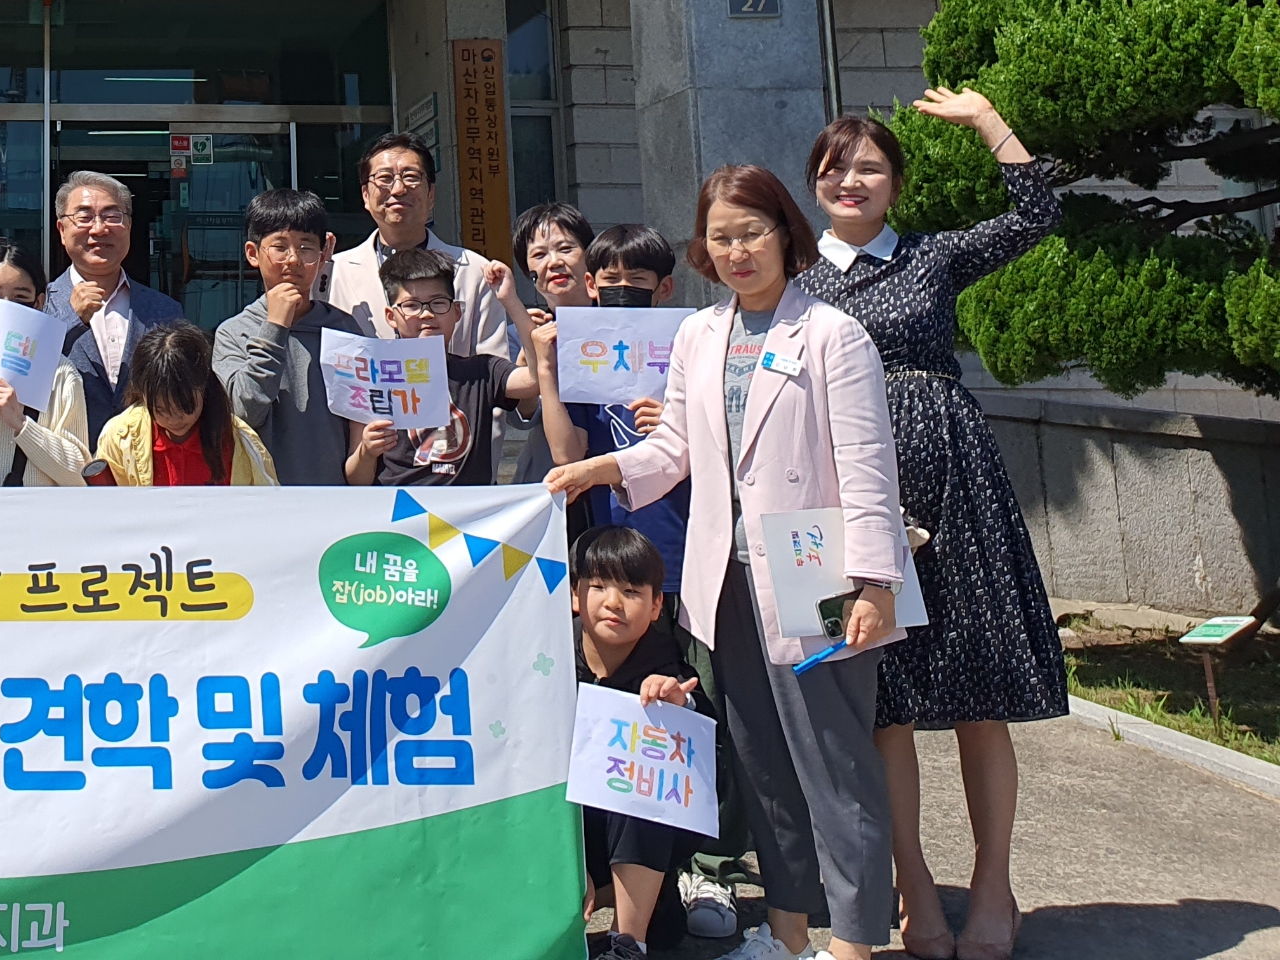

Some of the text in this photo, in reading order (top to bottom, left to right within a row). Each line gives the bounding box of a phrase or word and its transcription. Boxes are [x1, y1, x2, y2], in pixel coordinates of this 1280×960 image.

[482, 65, 501, 177] 산업통상자원부
[580, 340, 674, 375] 우체부
[729, 343, 763, 355] TRAUS
[334, 354, 431, 385] 프라모델
[348, 385, 421, 416] 조립가
[20, 545, 228, 618] 프로젝트
[355, 550, 419, 582] 내 꿈을
[332, 580, 439, 609] 잡(job)아라!
[196, 671, 287, 789] 및
[302, 665, 475, 786] 체험
[608, 718, 696, 768] 자동차
[606, 756, 694, 808] 정비사
